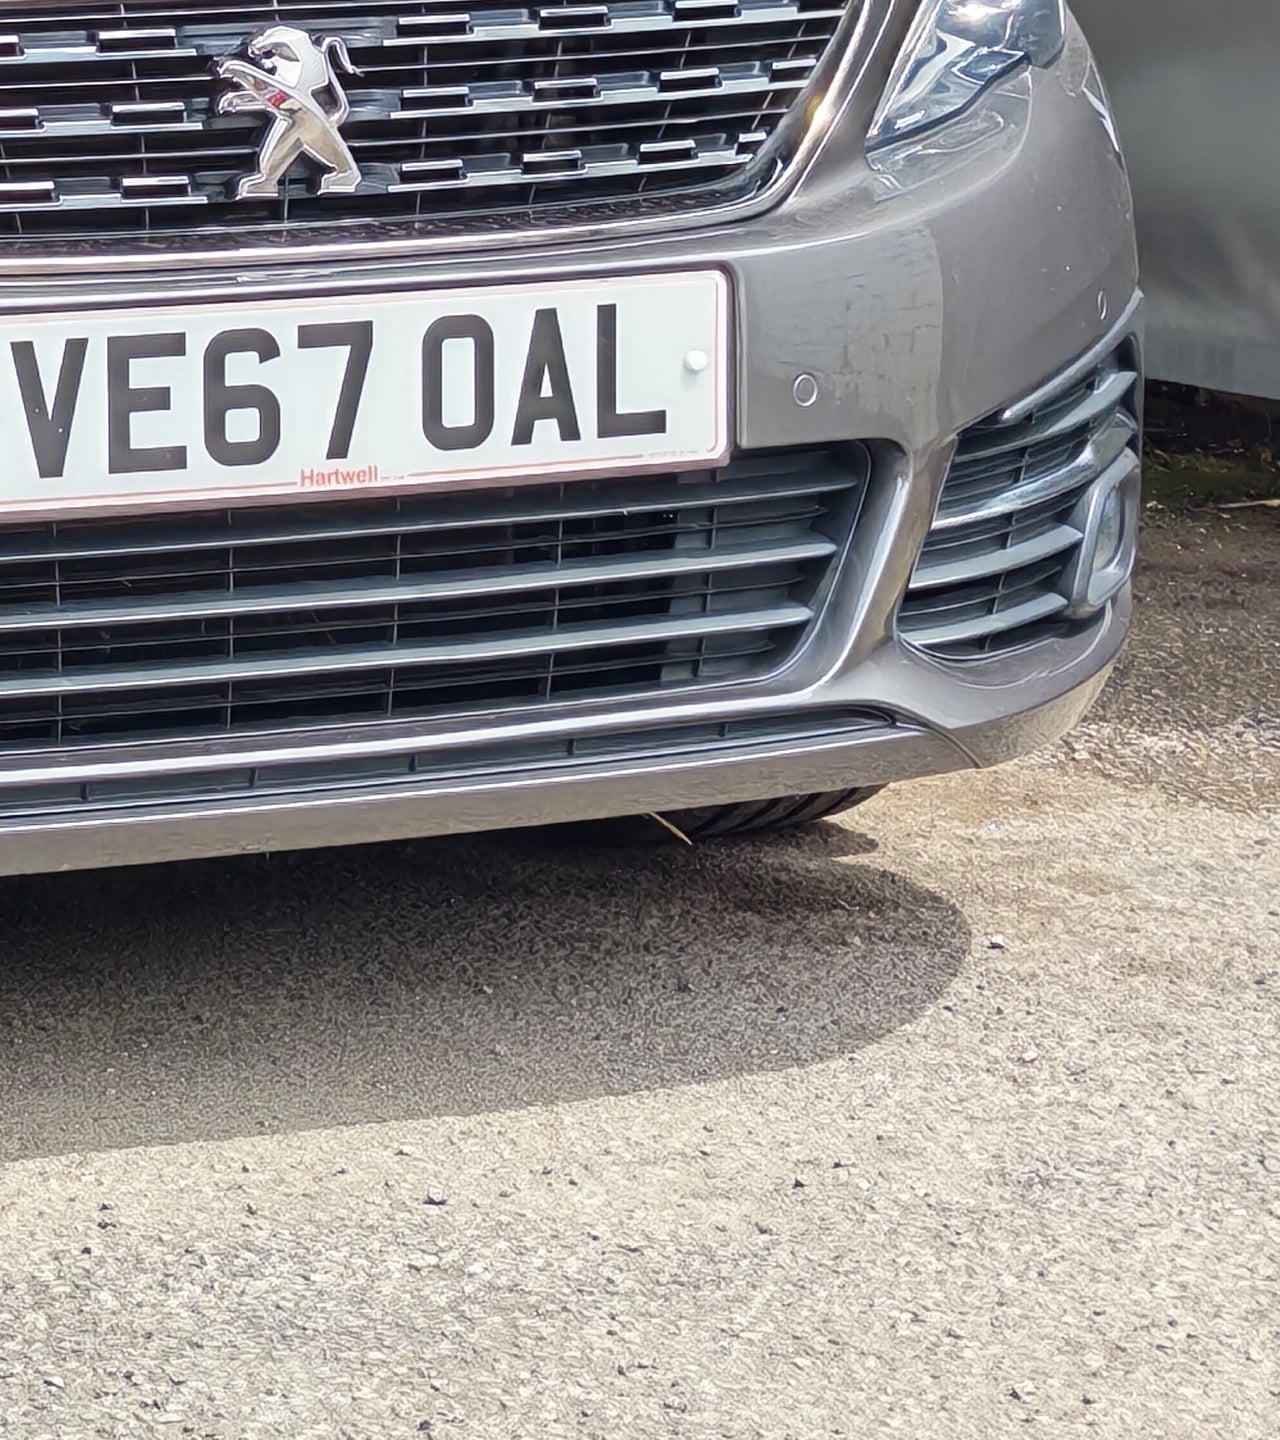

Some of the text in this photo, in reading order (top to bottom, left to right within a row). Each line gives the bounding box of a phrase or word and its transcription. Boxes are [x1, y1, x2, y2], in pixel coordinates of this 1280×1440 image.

[9, 303, 668, 480] VE67 OAL
[299, 464, 379, 488] Hartwell
